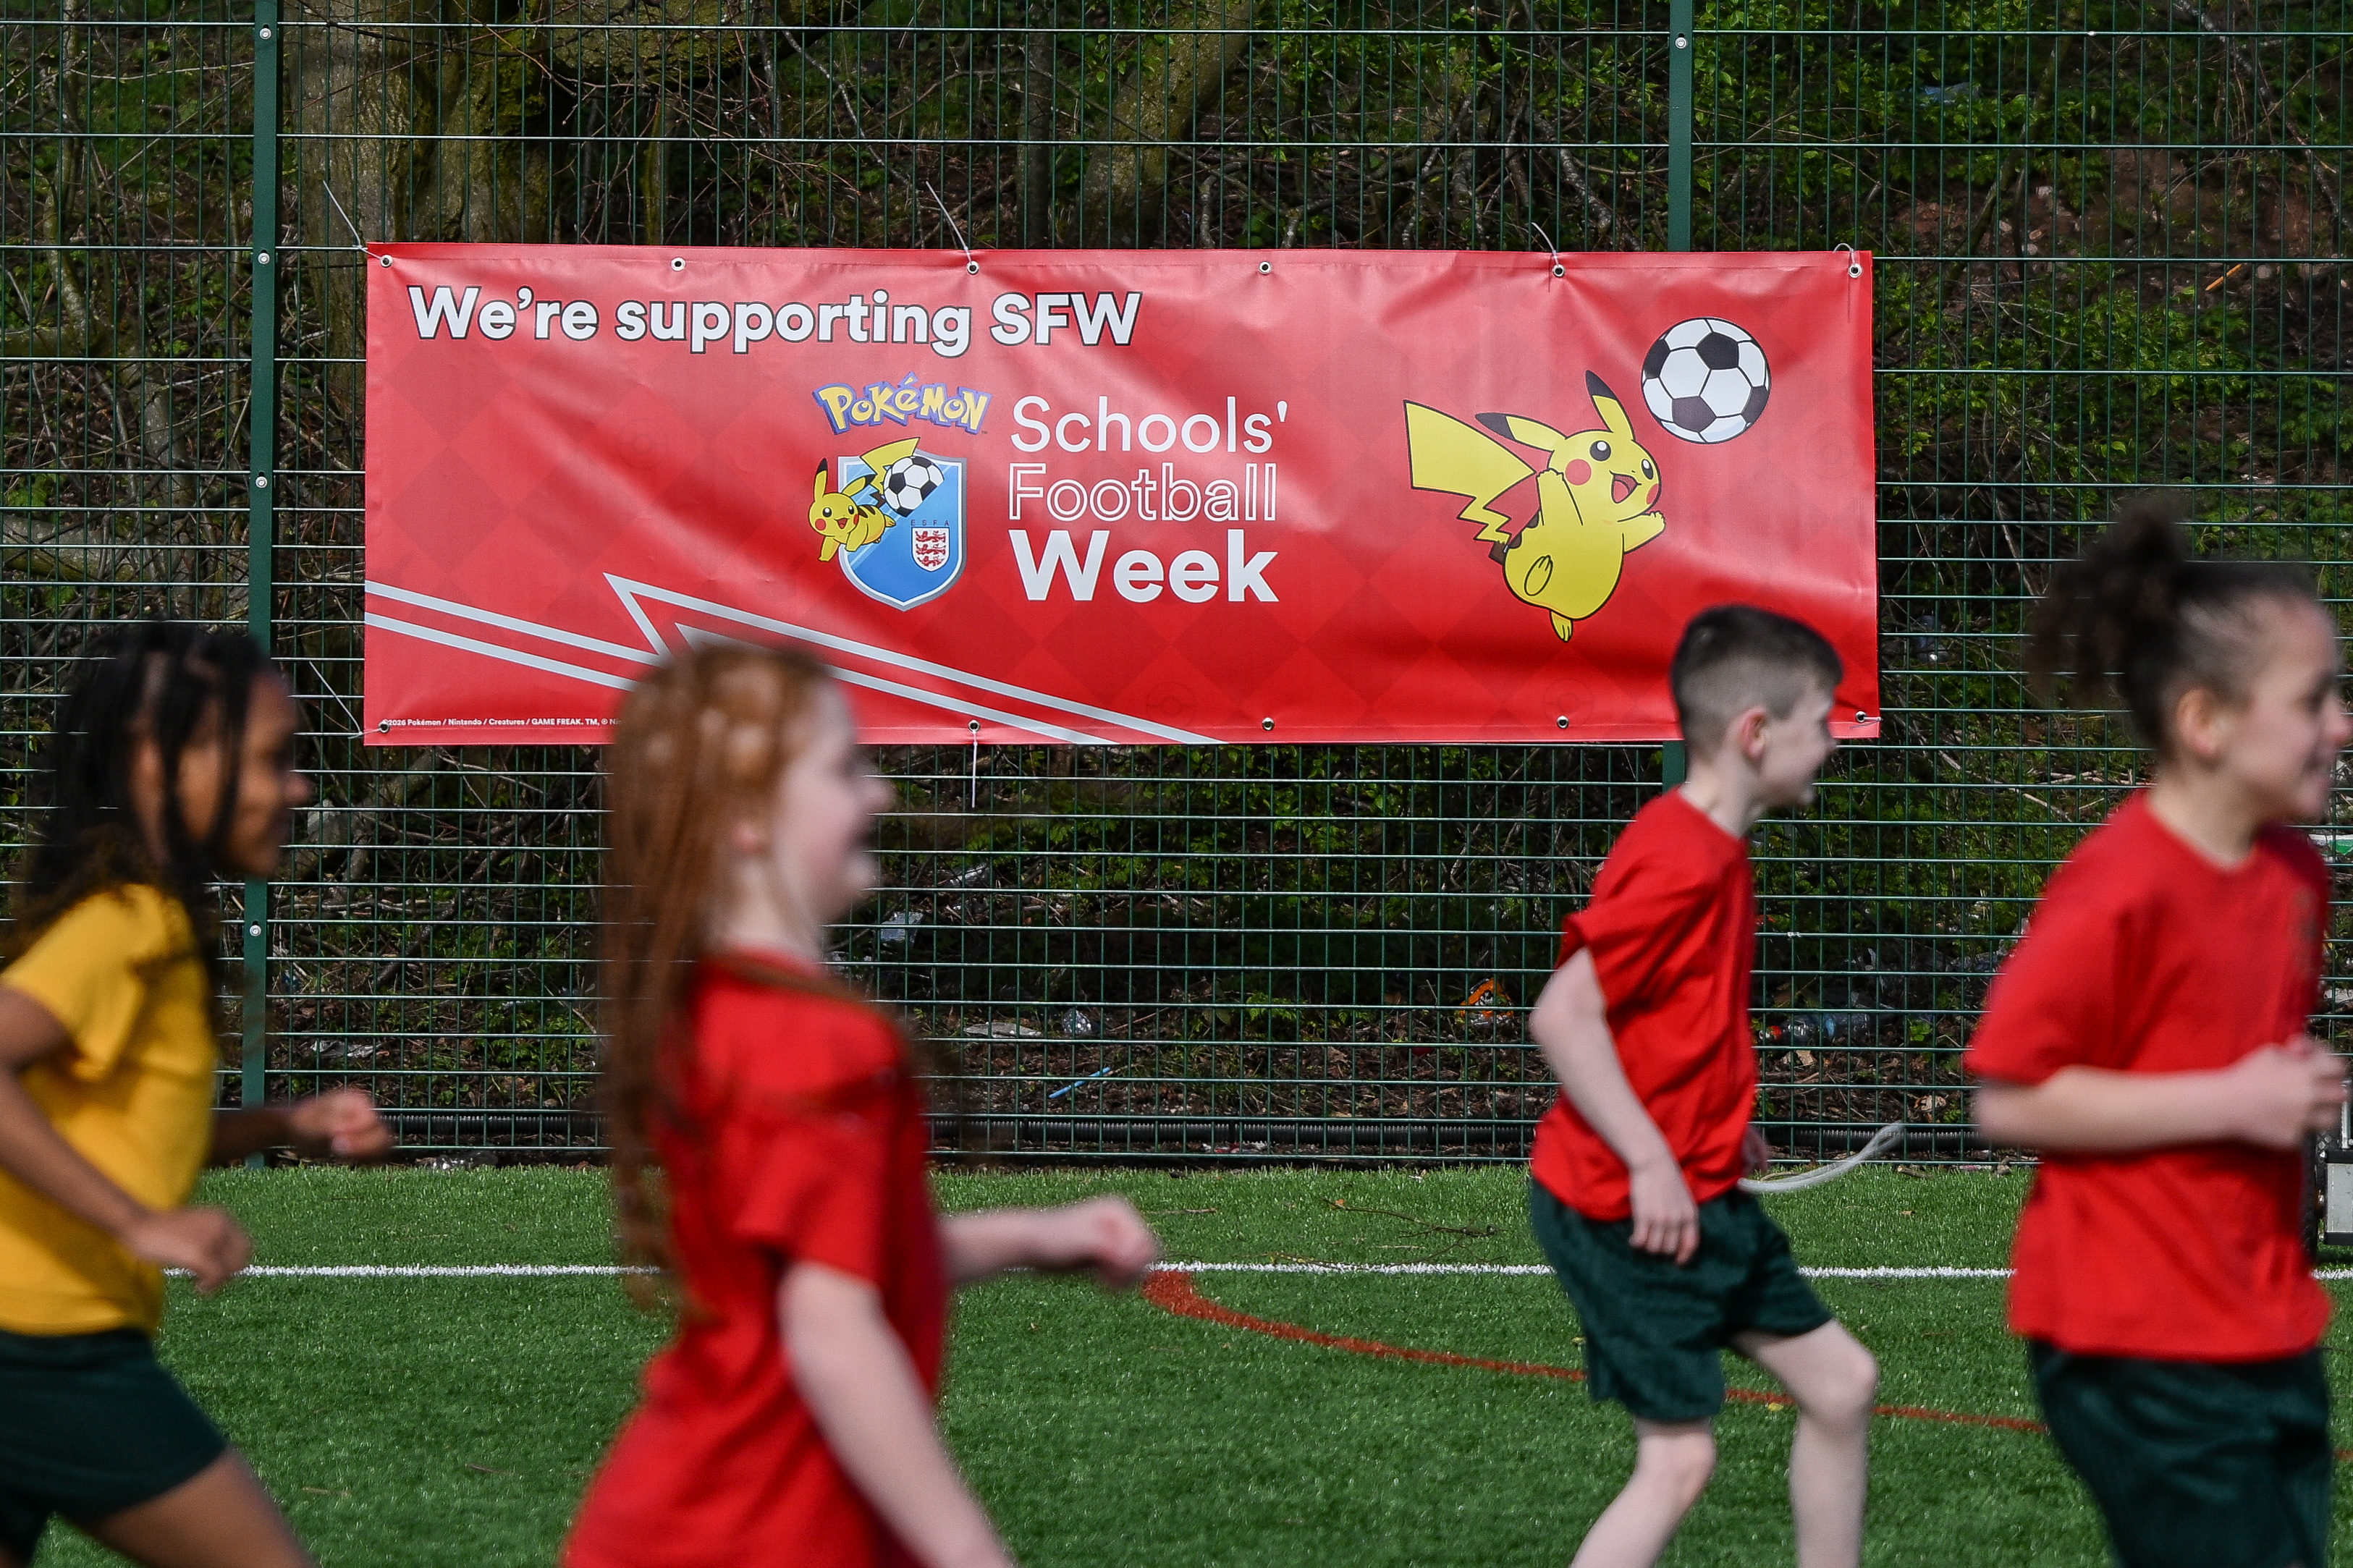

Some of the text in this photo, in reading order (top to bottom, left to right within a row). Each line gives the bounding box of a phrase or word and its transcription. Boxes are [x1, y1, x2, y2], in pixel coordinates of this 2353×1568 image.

[407, 285, 1143, 358] We’re supporting SFW
[1010, 396, 1288, 453] Schools'
[1009, 462, 1277, 522] Football
[1007, 529, 1280, 603] Week
